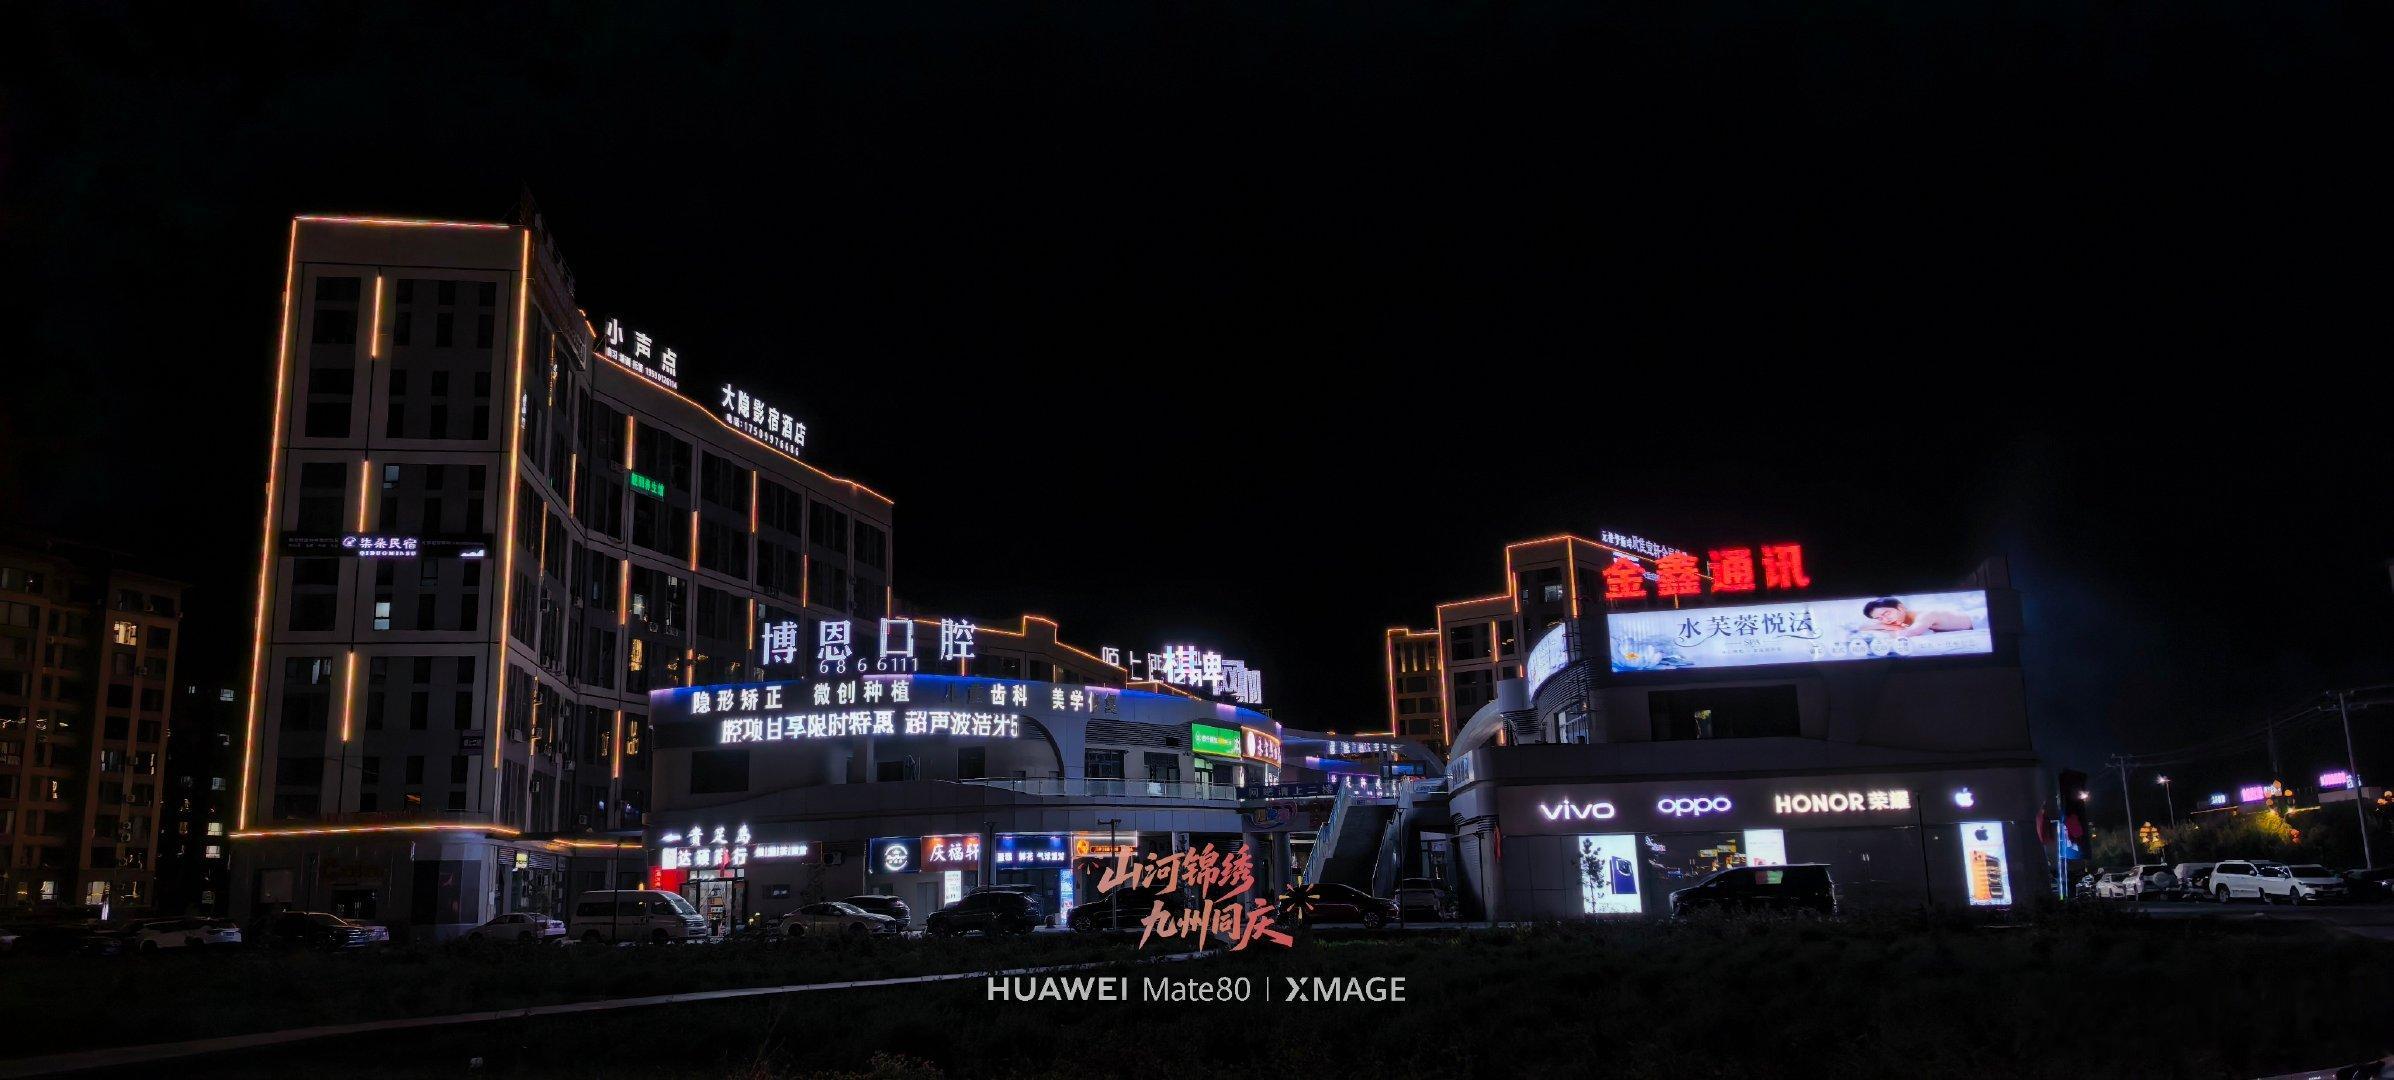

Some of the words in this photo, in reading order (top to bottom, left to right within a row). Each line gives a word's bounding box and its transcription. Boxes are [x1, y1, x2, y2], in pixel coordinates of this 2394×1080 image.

[606, 318, 678, 377] 小声点
[722, 383, 806, 447] 大隐影宿酒店
[1602, 544, 1810, 598] 金鑫通讯
[762, 618, 976, 665] 博恩口腔
[692, 685, 783, 714] 隐形矫正
[813, 680, 910, 705] 微创种植
[1540, 800, 1616, 820] vivo
[1658, 796, 1732, 817] oppo
[1775, 793, 1864, 814] HONOR
[1867, 790, 1911, 811] 荣耀
[929, 843, 979, 862] 庆福轩
